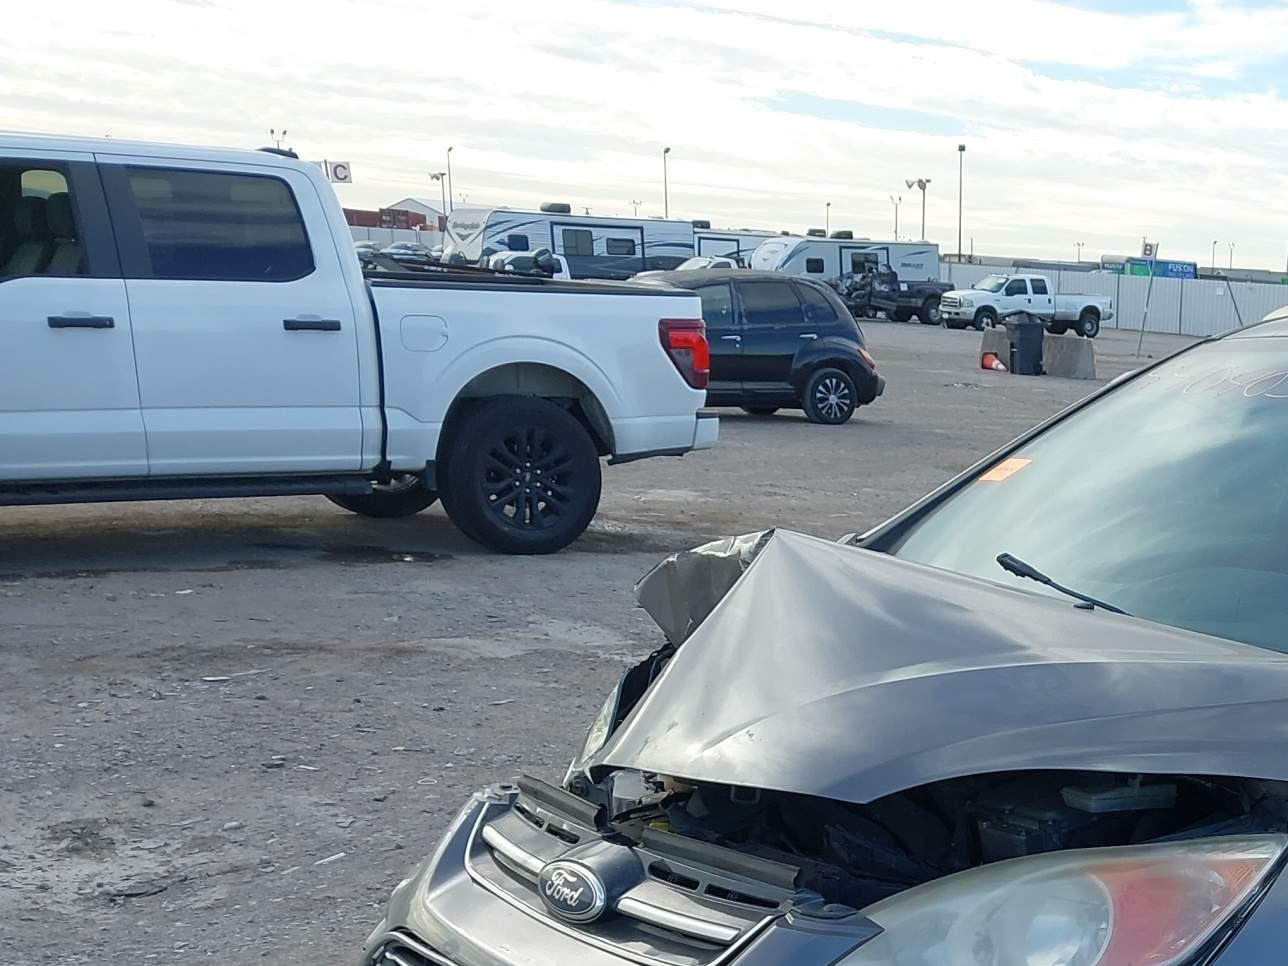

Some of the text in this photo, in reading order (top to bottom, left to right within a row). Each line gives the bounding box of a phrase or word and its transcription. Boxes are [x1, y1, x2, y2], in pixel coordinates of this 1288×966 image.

[333, 164, 348, 181] C
[1143, 243, 1153, 256] B
[545, 869, 584, 907] Ford
